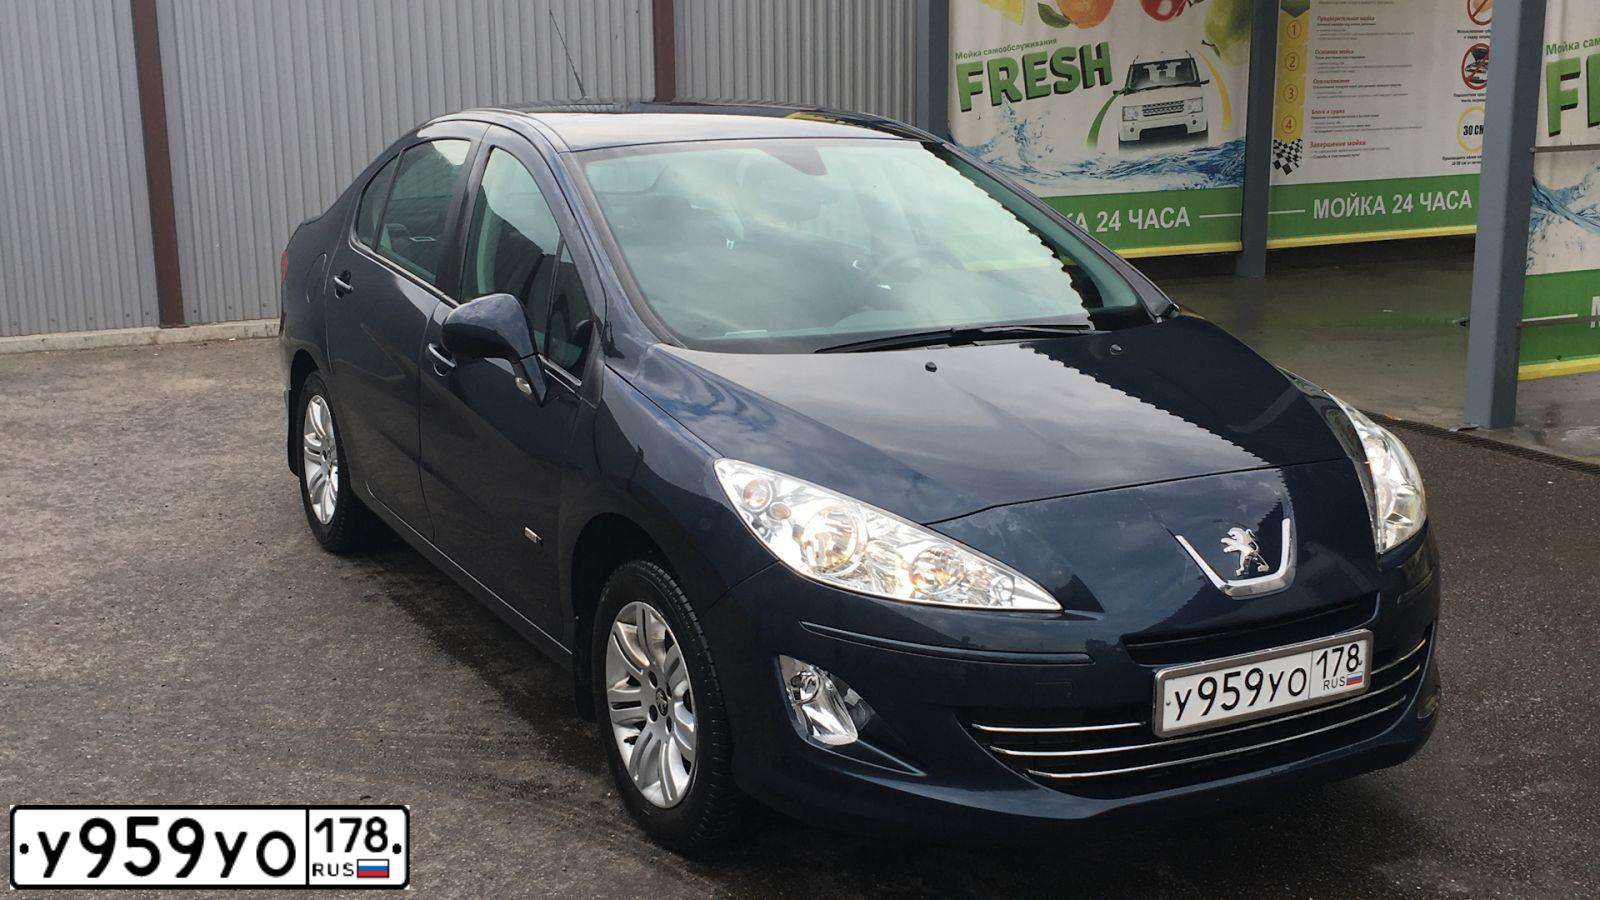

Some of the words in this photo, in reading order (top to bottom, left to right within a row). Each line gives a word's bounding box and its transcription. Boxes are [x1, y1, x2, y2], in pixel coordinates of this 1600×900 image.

[955, 50, 982, 60] Мойка
[983, 38, 1057, 56] самообслуживания
[1546, 41, 1580, 55] Мойка
[1289, 56, 1296, 68] 2
[956, 42, 1113, 112] FRESH
[1288, 87, 1295, 99] 3
[1285, 119, 1293, 131] 4
[1463, 125, 1473, 135] 30
[1313, 193, 1386, 219] МОЙКА
[1392, 194, 1413, 214] 24
[1419, 190, 1473, 212] ЧАСА
[1096, 211, 1121, 232] 24
[1128, 206, 1190, 230] ЧАСА
[1316, 643, 1360, 679] 178
[1323, 676, 1346, 691] RUS
